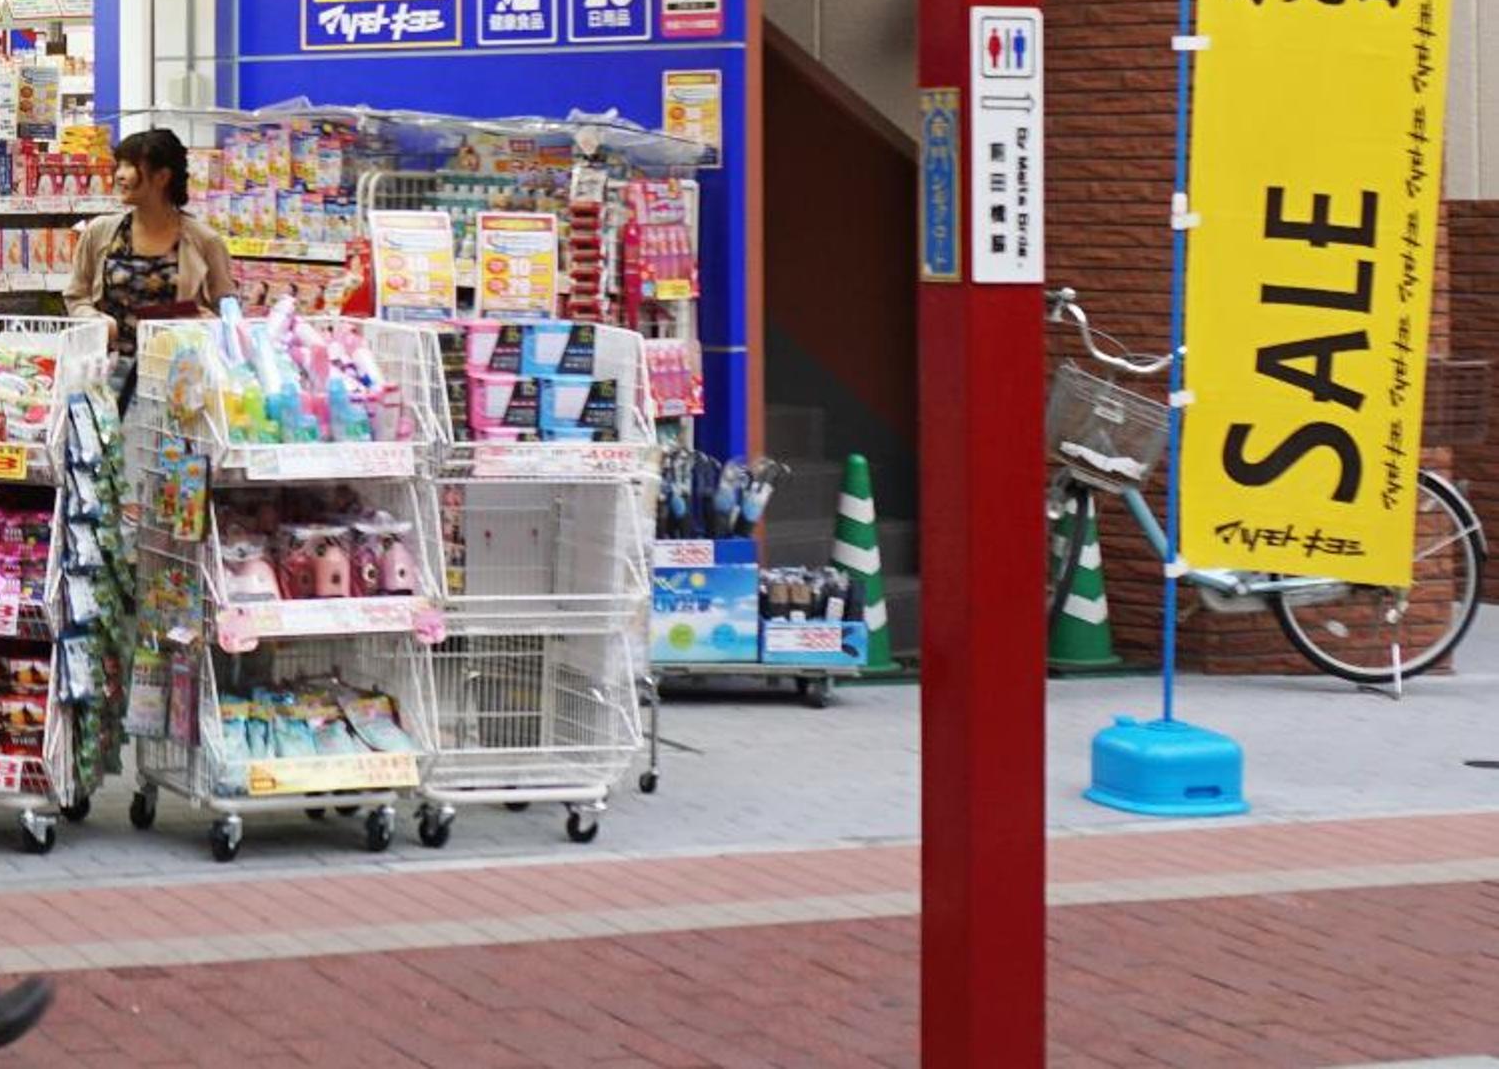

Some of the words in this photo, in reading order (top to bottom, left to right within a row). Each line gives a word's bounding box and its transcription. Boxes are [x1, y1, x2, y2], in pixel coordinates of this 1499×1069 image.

[318, 3, 445, 42] マツモトキヨシ
[588, 9, 631, 28] 日用品
[1222, 185, 1379, 505] SALE
[1214, 519, 1366, 559] マツモトキヨシ
